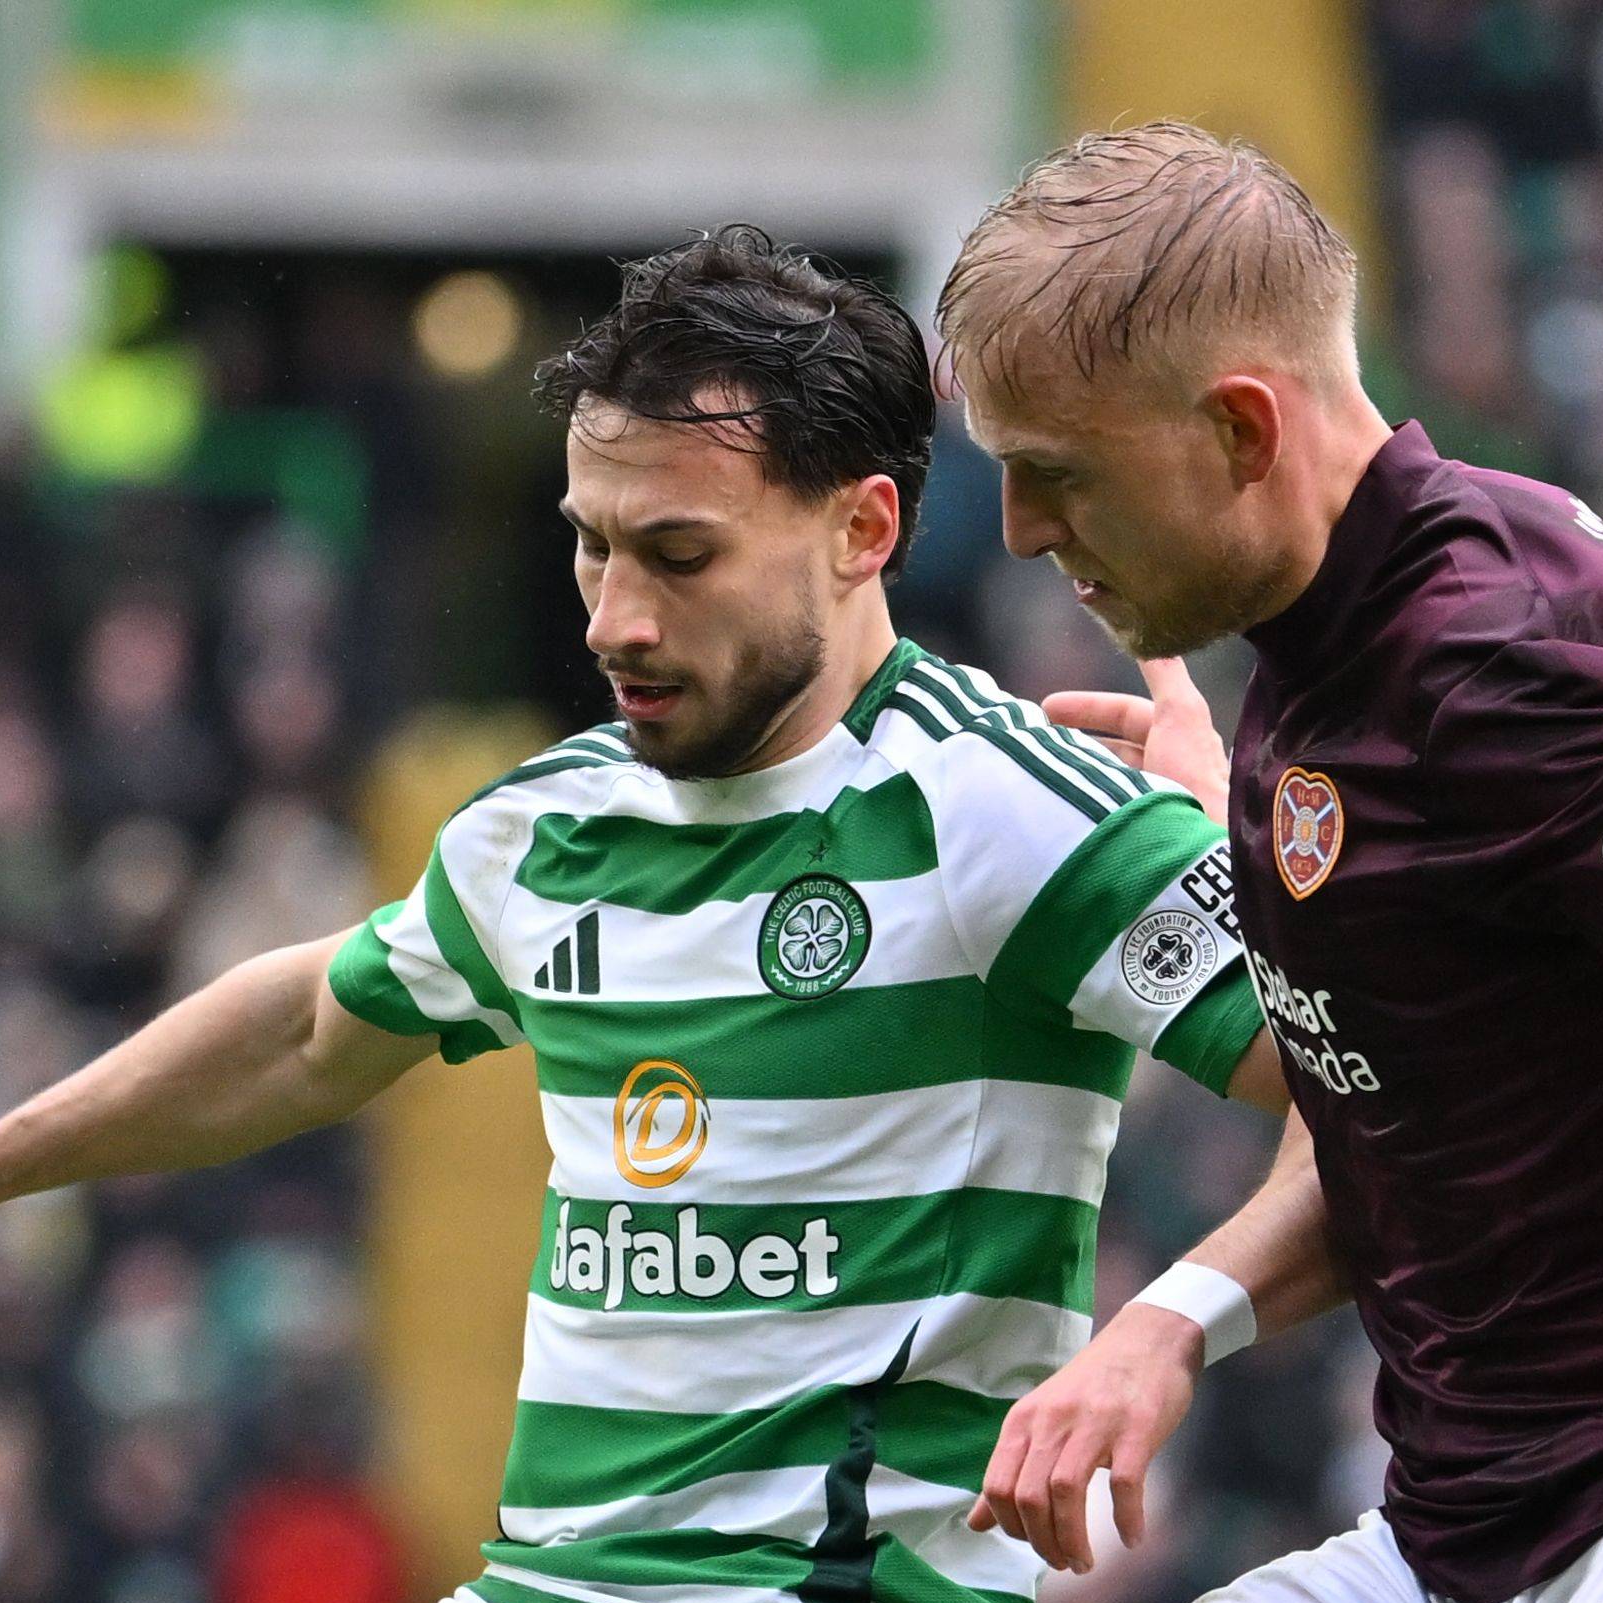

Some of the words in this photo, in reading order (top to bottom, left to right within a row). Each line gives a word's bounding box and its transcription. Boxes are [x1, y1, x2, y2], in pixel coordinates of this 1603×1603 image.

[765, 921, 779, 943] THE
[774, 886, 803, 919] CELTIC
[802, 881, 852, 909] FOOTBALL
[848, 904, 865, 936] CLUB
[1126, 950, 1140, 982] CELTIC
[1139, 914, 1193, 937] FOUNDATION
[550, 1200, 840, 1312] dafabet
